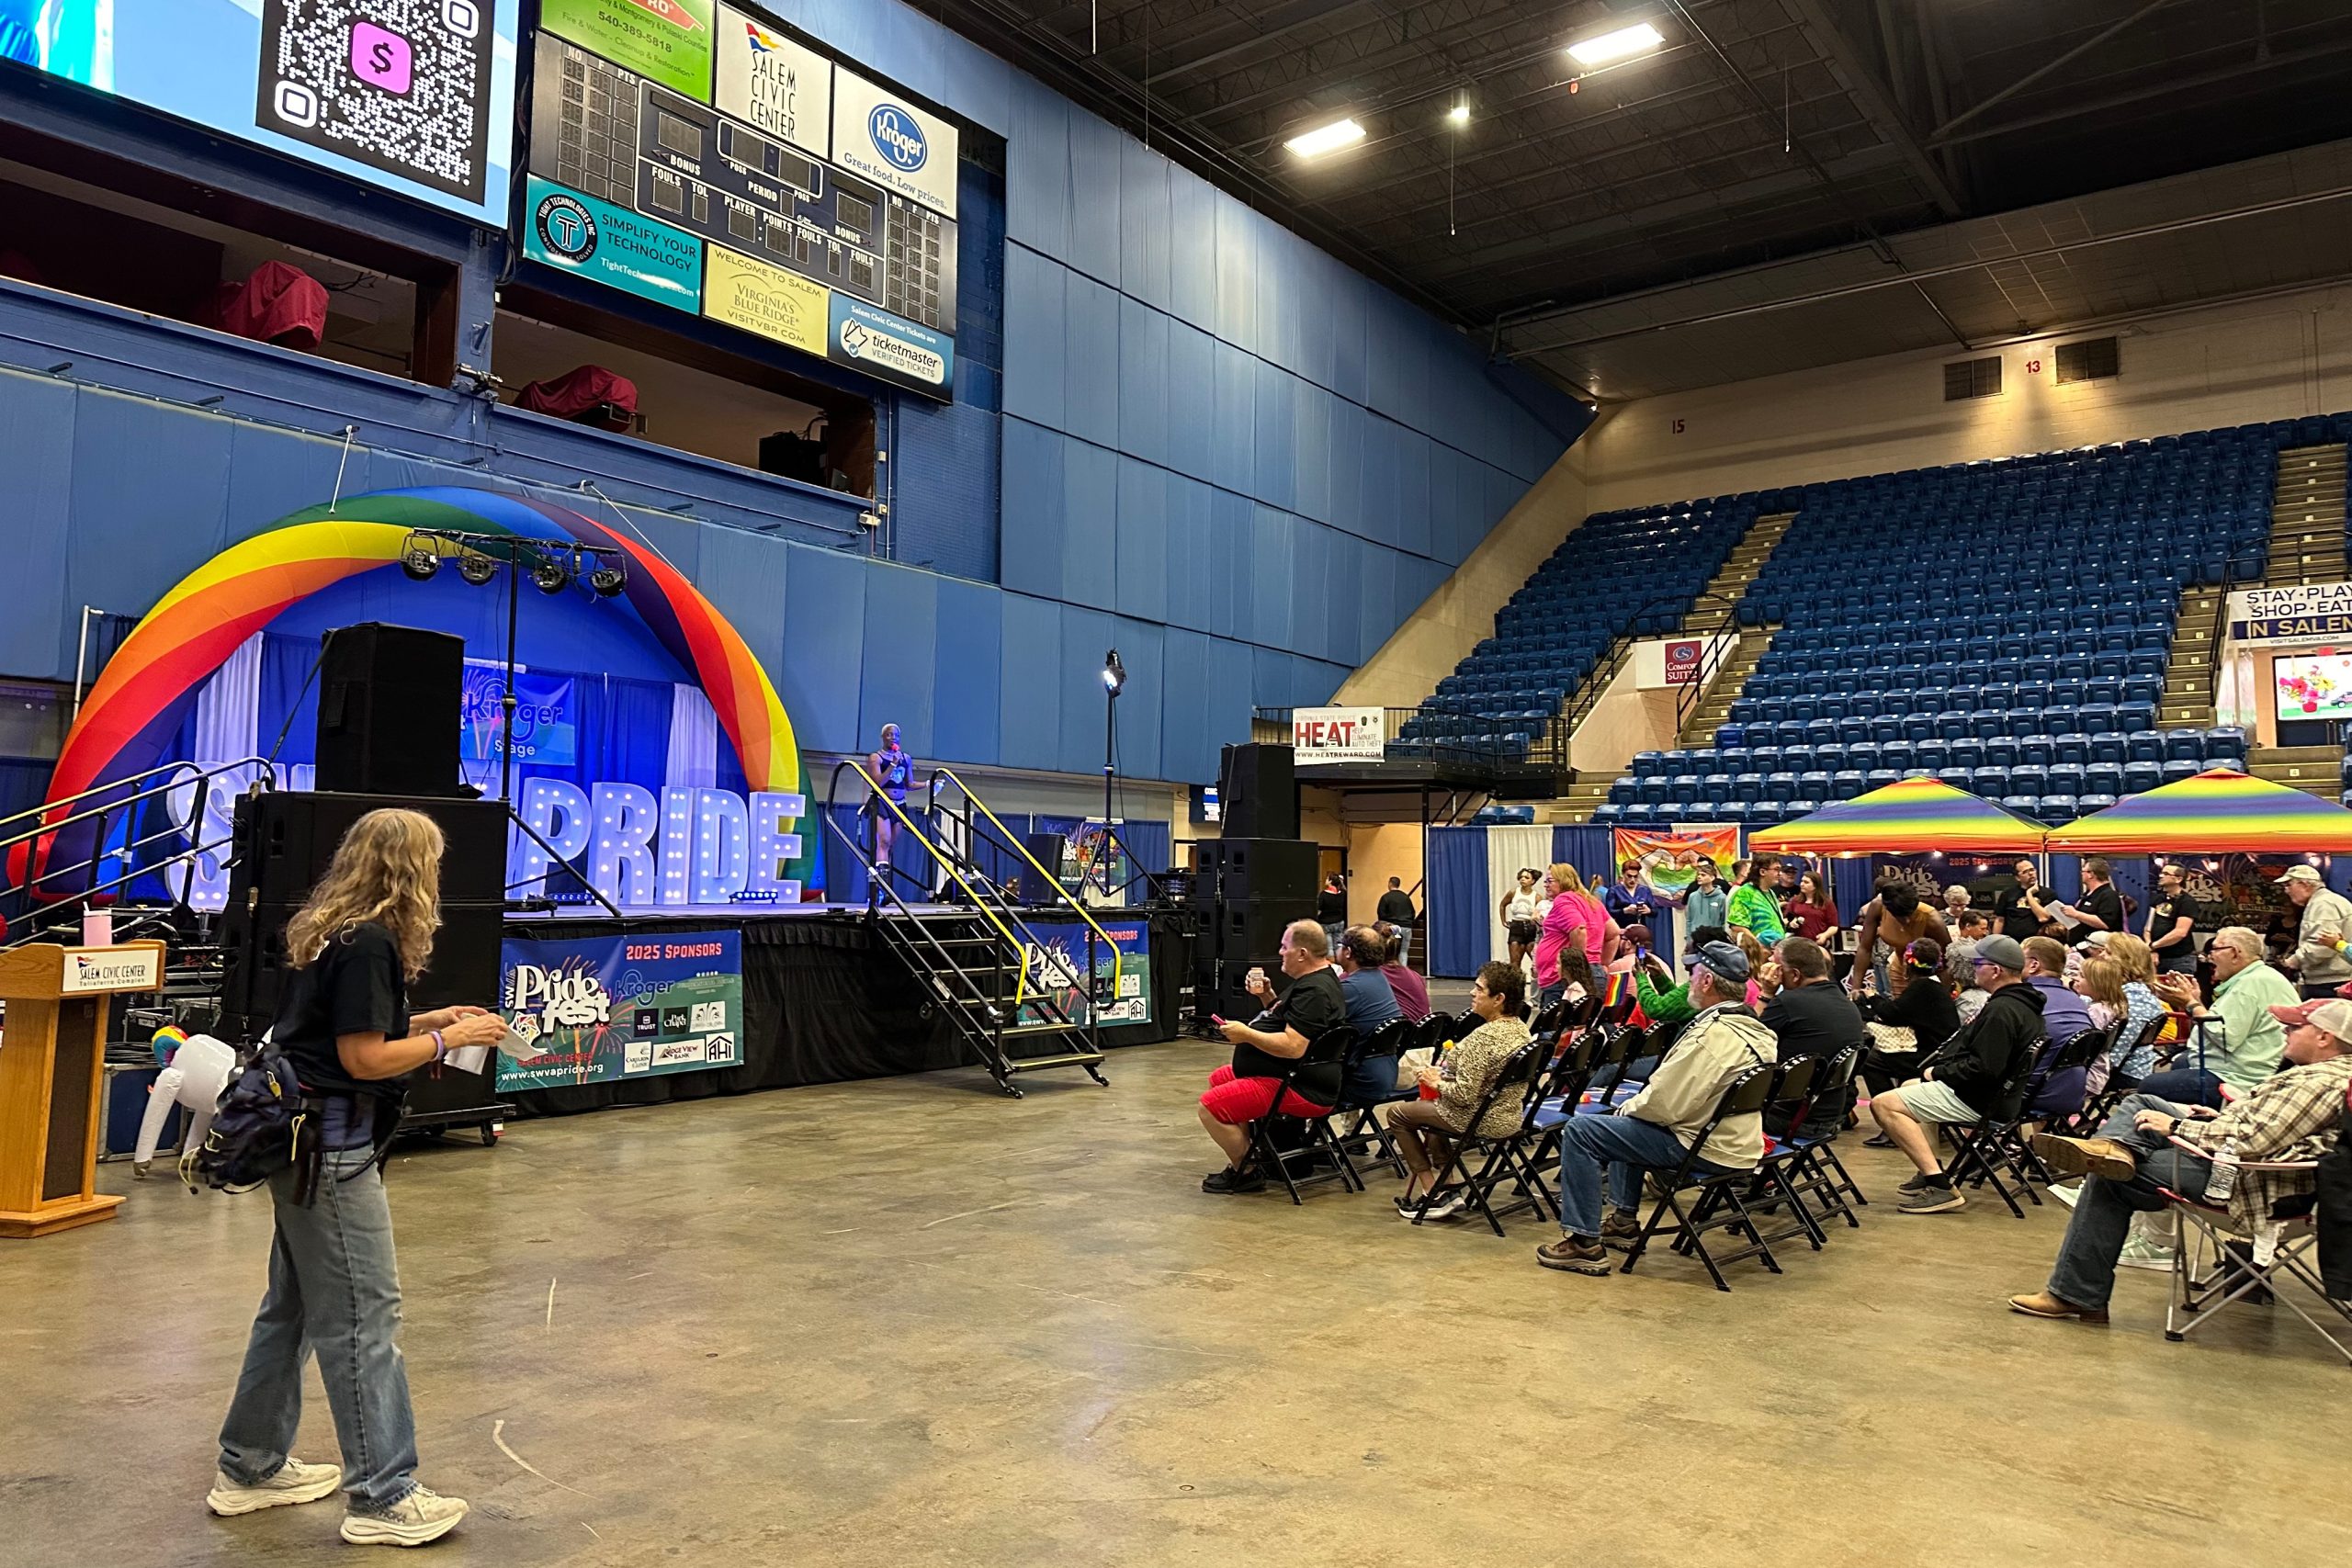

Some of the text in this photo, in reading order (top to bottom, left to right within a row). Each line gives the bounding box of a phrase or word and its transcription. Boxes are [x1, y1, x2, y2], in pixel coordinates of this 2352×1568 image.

[562, 12, 576, 25] Fire
[585, 24, 608, 38] Water
[615, 37, 645, 57] Cleanup
[598, 10, 673, 52] 540-389-5818
[619, 4, 655, 28] Montgomery
[684, 36, 707, 52] Counties
[568, 46, 582, 61] NO
[598, 60, 605, 70] F
[752, 51, 796, 91] SALEM
[617, 69, 636, 85] PTS
[752, 74, 796, 115] CIVIC
[751, 99, 795, 140] CENTER
[876, 111, 922, 164] Kroger
[670, 153, 701, 175] BONUS
[729, 162, 747, 175] POSS
[651, 166, 681, 187] FOULS
[844, 152, 947, 209] Great food. Low prices.
[691, 182, 708, 198] TOL
[748, 181, 777, 202] PERIOD
[794, 190, 810, 203] POSS
[724, 197, 756, 216] PLAYER
[892, 195, 902, 207] NO
[912, 205, 918, 214] F
[538, 197, 595, 236] TIGHT TECHNOLOGIES INC
[763, 213, 793, 233] POINTS
[926, 210, 939, 224] PTS
[602, 214, 696, 258] SIMPLIFY YOUR
[797, 226, 822, 245] FOULS
[834, 225, 861, 244] BONUS
[576, 244, 594, 261] SOLVED
[606, 231, 692, 272] TECHNOLOGY
[827, 240, 842, 254] TOL
[851, 249, 875, 266] FOULS
[715, 249, 821, 298] WELCOME TO SALEM
[734, 294, 761, 313] BLUE
[737, 282, 795, 314] VIRGINIA'S
[851, 305, 936, 344] Salem Civic Center Tickets are
[873, 334, 938, 368] ticketmaster
[871, 348, 935, 378] VERIFIED TICKETS
[2026, 360, 2041, 373] 13
[1672, 419, 1685, 434] 15
[2246, 589, 2296, 604] STAY
[2251, 603, 2307, 617] SHOP
[2269, 635, 2339, 644] VISITSALEMVA.COM
[1295, 722, 1356, 748] HEAT
[494, 739, 536, 758] Sage
[514, 777, 806, 905] PRIDE
[1949, 858, 1970, 866] 2025
[627, 942, 722, 960] 2025 SPONSORS
[80, 964, 145, 980] SALEM CIVIC CENTER
[514, 964, 599, 1010] Pride
[615, 969, 675, 1007] Kroger
[542, 990, 611, 1033] fest
[544, 1054, 563, 1065] CIVIC
[565, 1052, 593, 1063] CENTER
[502, 1064, 604, 1080] www.swvapride.org
